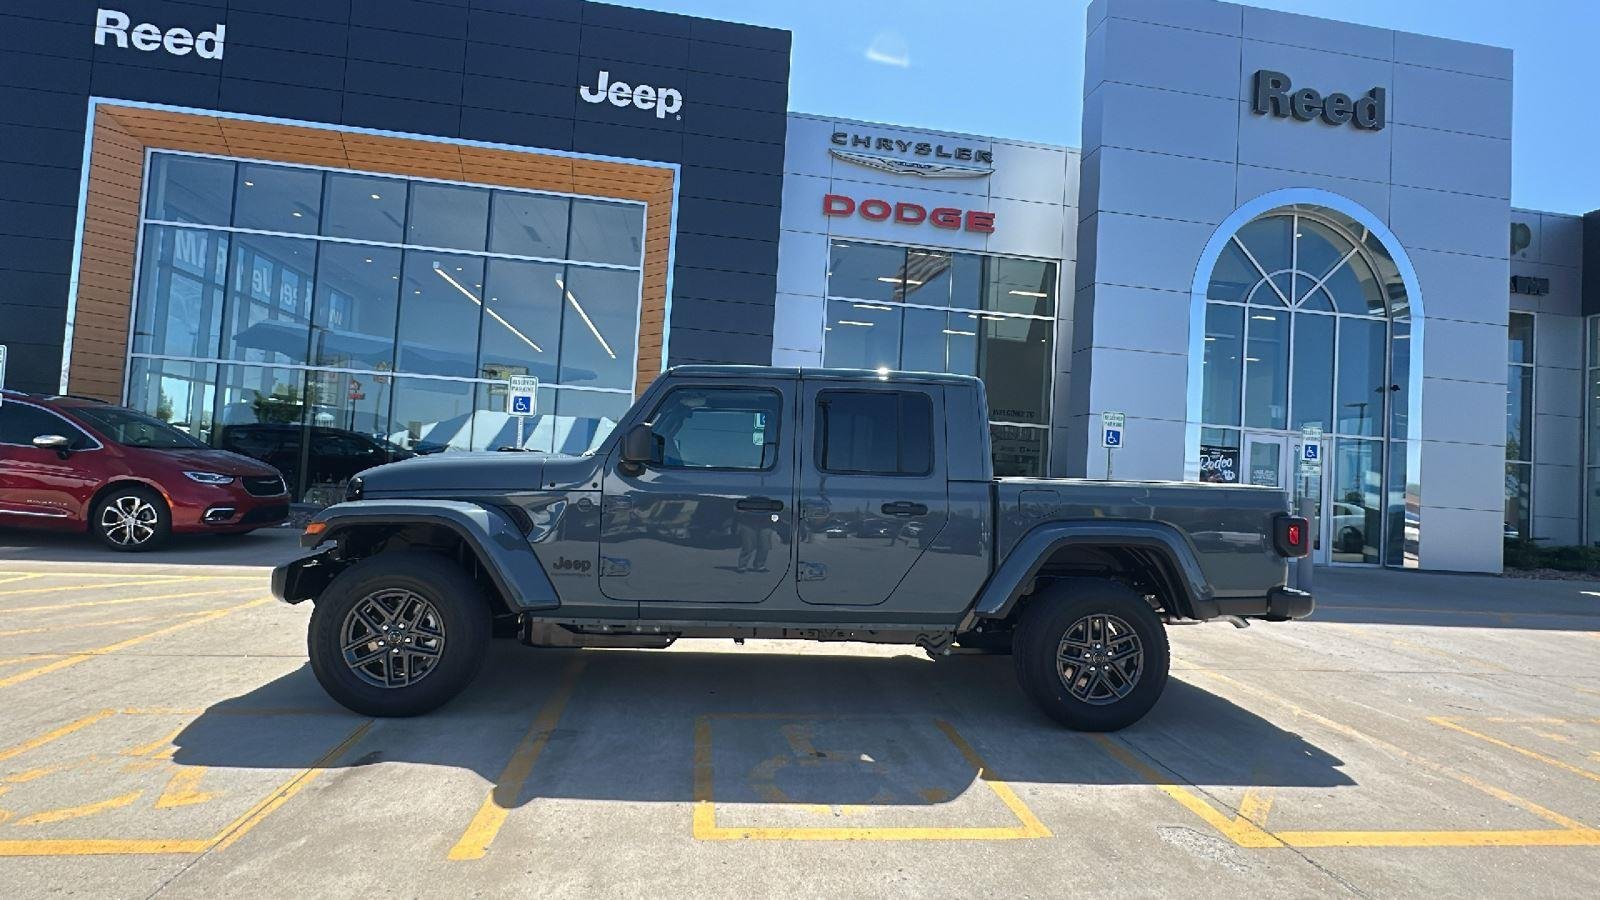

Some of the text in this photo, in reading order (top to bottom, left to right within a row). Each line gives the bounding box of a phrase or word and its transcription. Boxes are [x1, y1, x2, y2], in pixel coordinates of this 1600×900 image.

[94, 8, 226, 60] Reed
[580, 71, 682, 119] Jeep
[1252, 69, 1386, 131] Reed
[830, 132, 993, 163] CHRYSLER
[823, 194, 996, 233] DODGE
[553, 557, 591, 572] Jeep
